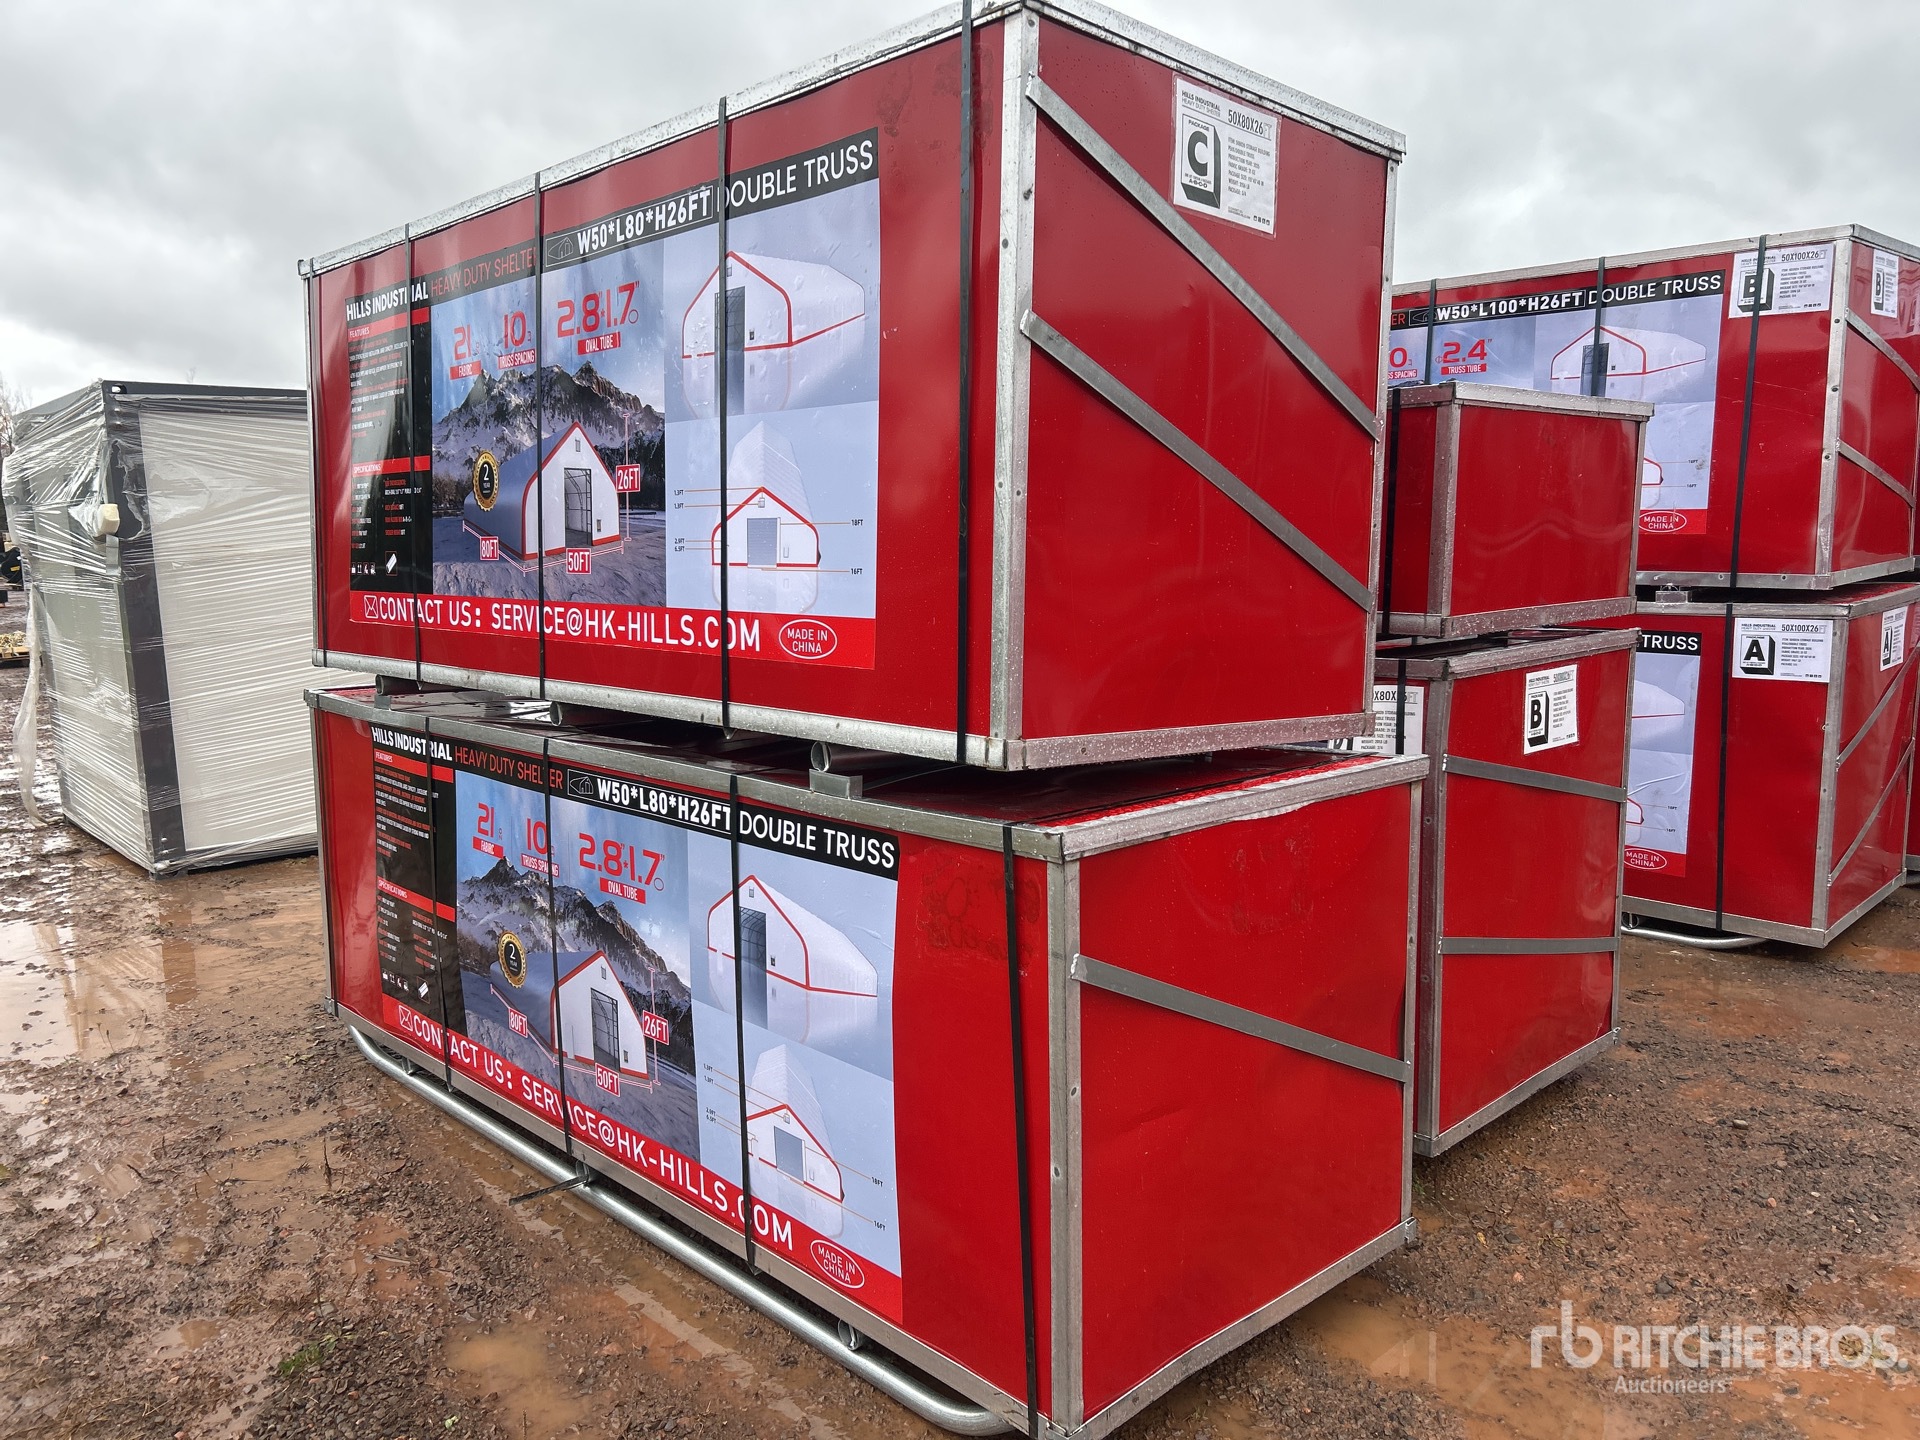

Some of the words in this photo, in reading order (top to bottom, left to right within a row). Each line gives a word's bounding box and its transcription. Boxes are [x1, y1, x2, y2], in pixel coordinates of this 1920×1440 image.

[1182, 90, 1194, 101] HILLS
[1188, 130, 1208, 177] C
[804, 140, 873, 188] TRUSS
[431, 272, 462, 295] HEAVY
[464, 262, 491, 288] DUTY
[1588, 284, 1656, 305] DOUBLE
[1662, 274, 1721, 294] TRUSS
[346, 301, 372, 321] HILLS
[503, 310, 527, 349] 10
[454, 324, 471, 360] 21
[585, 339, 599, 353] OVAL
[600, 334, 614, 350] TUBE
[500, 355, 514, 368] TRUSS
[514, 350, 534, 366] SPACING
[1394, 370, 1417, 379] SPACING
[1448, 366, 1466, 374] TRUSS
[484, 464, 489, 480] 2
[618, 470, 639, 490] 26FT
[481, 539, 498, 558] 80FT
[568, 552, 590, 572] 50FT
[379, 596, 443, 624] CONTACT
[787, 628, 815, 640] MADE
[818, 630, 828, 641] IN
[1642, 634, 1698, 651] TRUSS
[792, 640, 822, 654] CHINA
[1744, 640, 1765, 661] A
[1531, 699, 1542, 729] B
[371, 727, 394, 746] HILLS
[455, 746, 487, 770] HEAVY
[490, 754, 515, 777] DUTY
[518, 761, 563, 790] SHELER
[478, 803, 494, 838] 21
[527, 818, 548, 854] 10
[740, 810, 816, 851] DOUBLE
[823, 828, 895, 869] TRUSS
[522, 854, 538, 870] TRUSS
[1626, 851, 1648, 860] MADE
[1630, 858, 1655, 868] CHINA
[608, 881, 622, 896] OVAL
[623, 885, 638, 901] TUBE
[509, 944, 516, 960] 2
[510, 1010, 527, 1036] 80FT
[644, 1015, 668, 1042] 26FT
[597, 1067, 619, 1094] 50FT
[874, 1220, 886, 1231] 16FT
[818, 1244, 842, 1268] MADE
[846, 1261, 855, 1275] IN
[824, 1259, 851, 1284] CHINA
